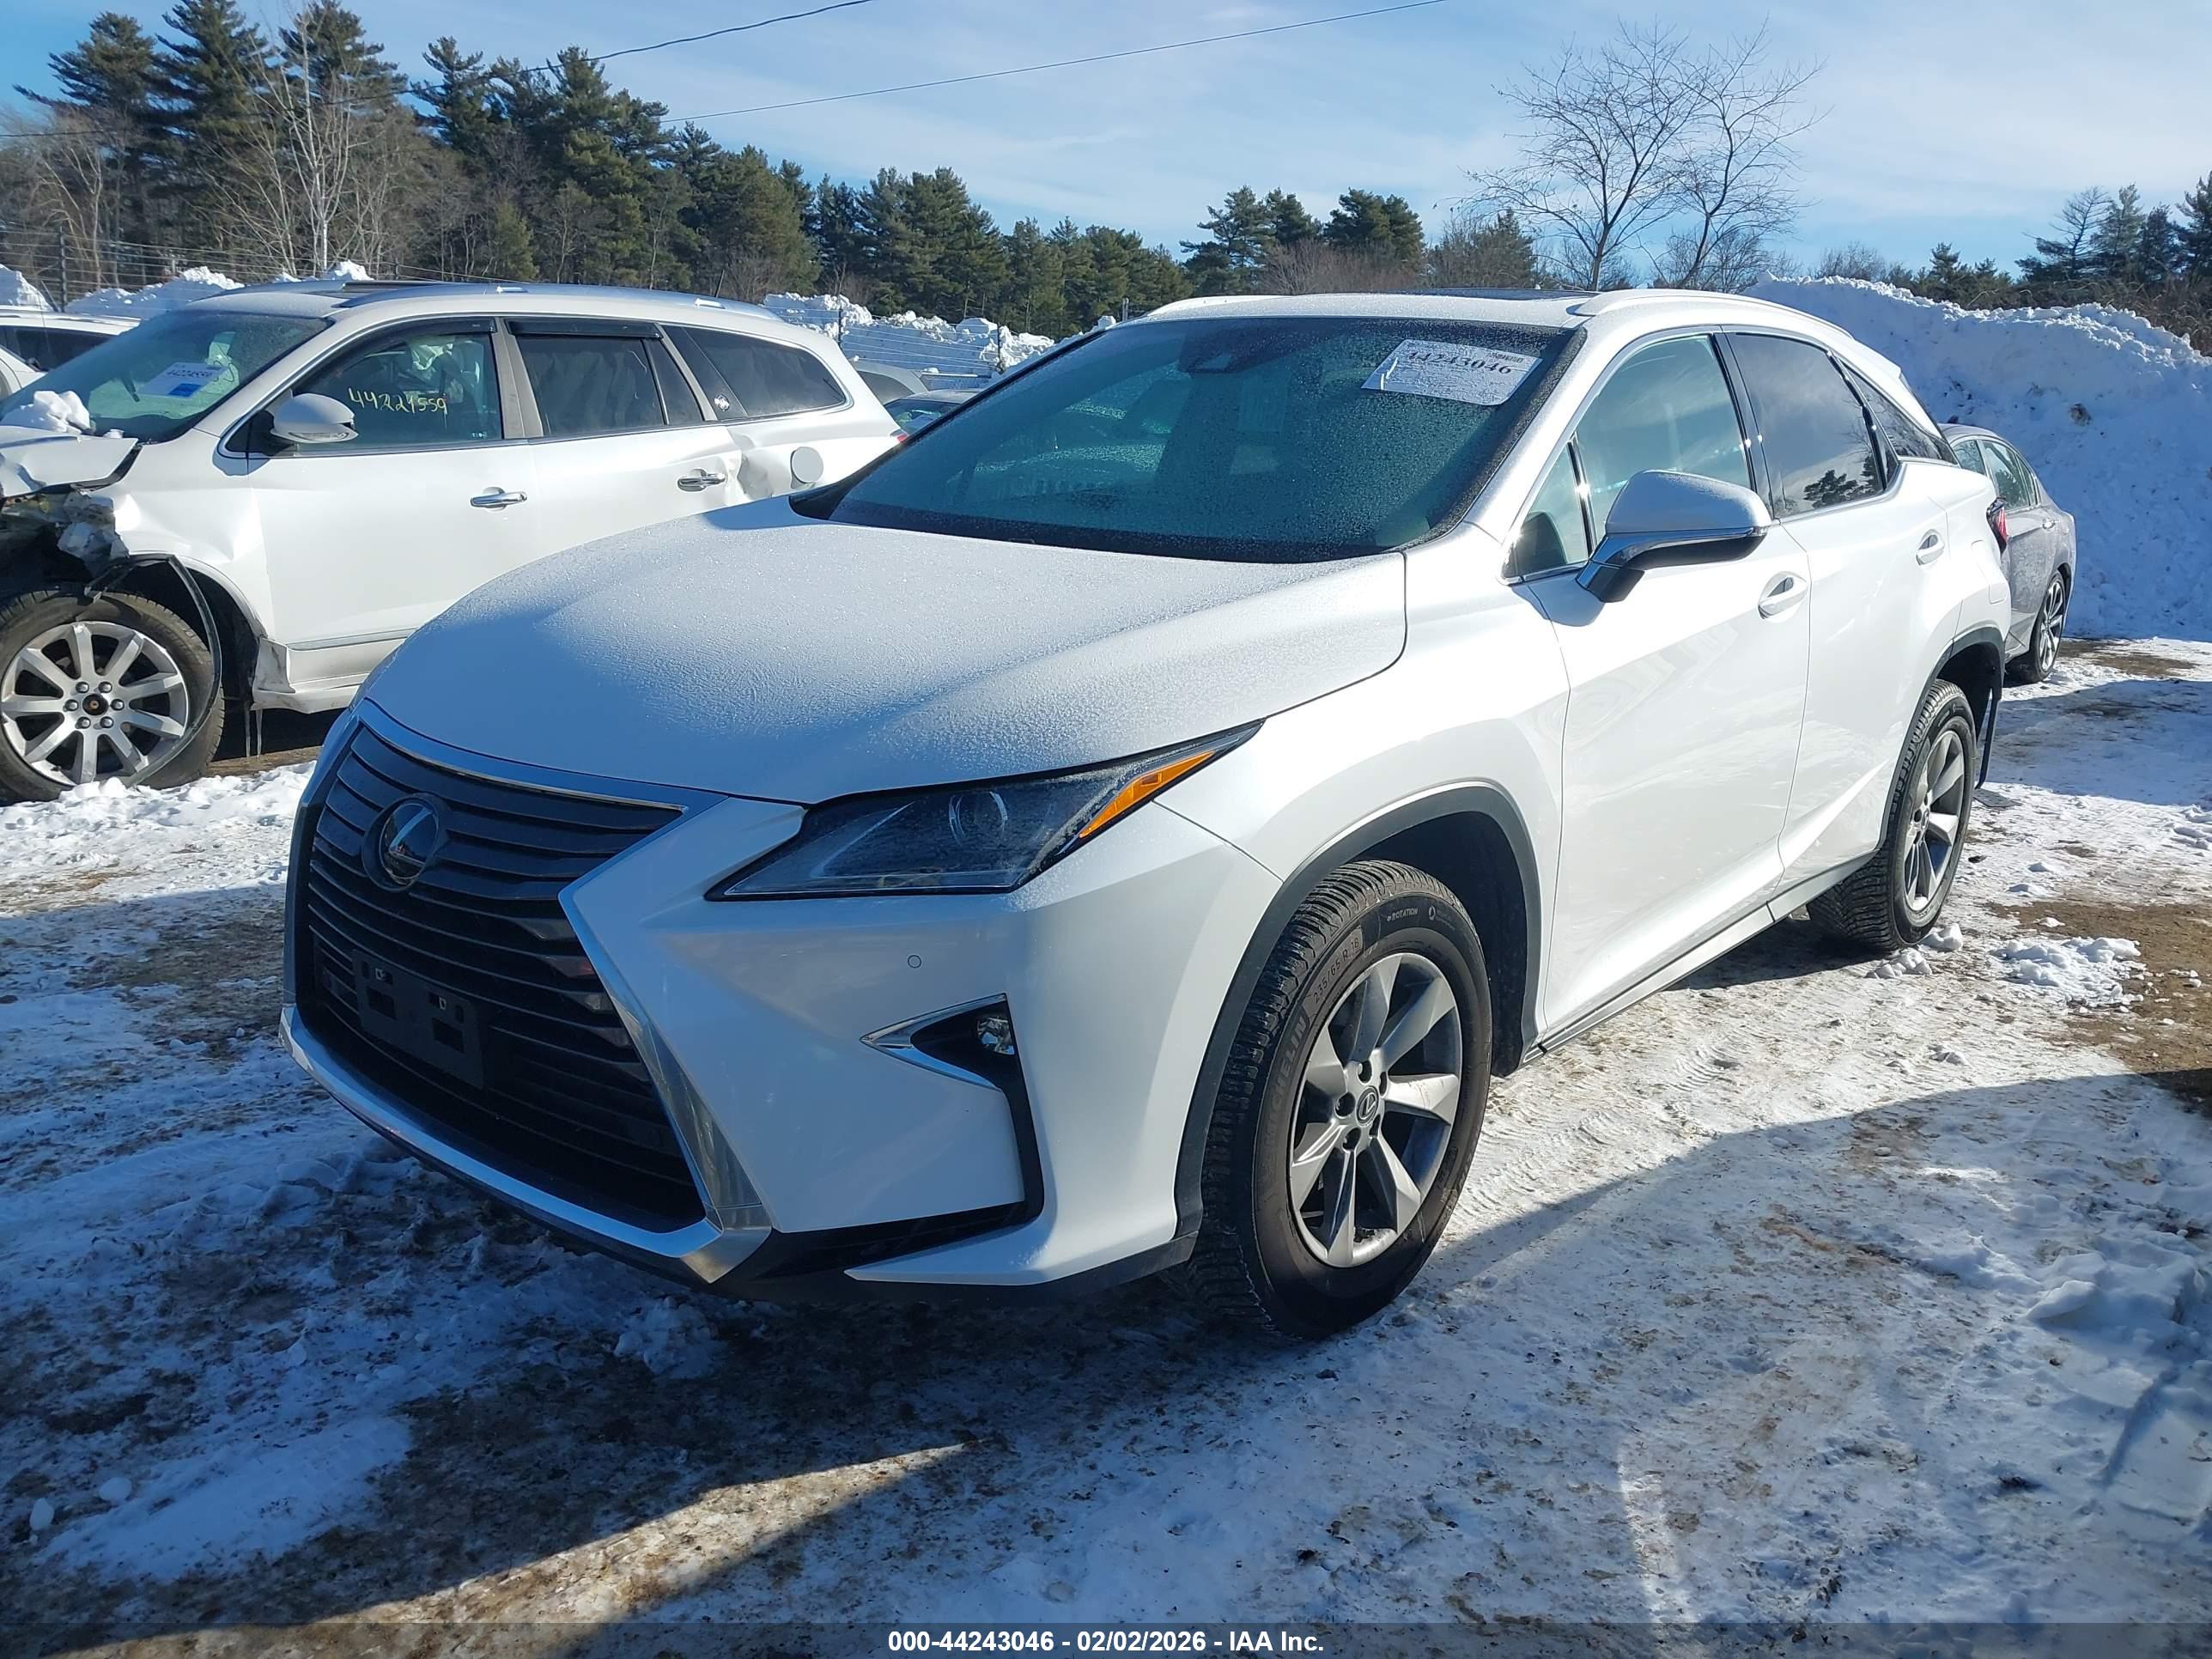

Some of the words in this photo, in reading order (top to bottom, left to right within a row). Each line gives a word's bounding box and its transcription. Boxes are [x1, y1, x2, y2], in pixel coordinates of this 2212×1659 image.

[1313, 957, 1341, 1004] 235/65
[1342, 949, 1349, 960] R
[1351, 937, 1360, 951] 18
[1264, 1016, 1307, 1148] MICHELIN
